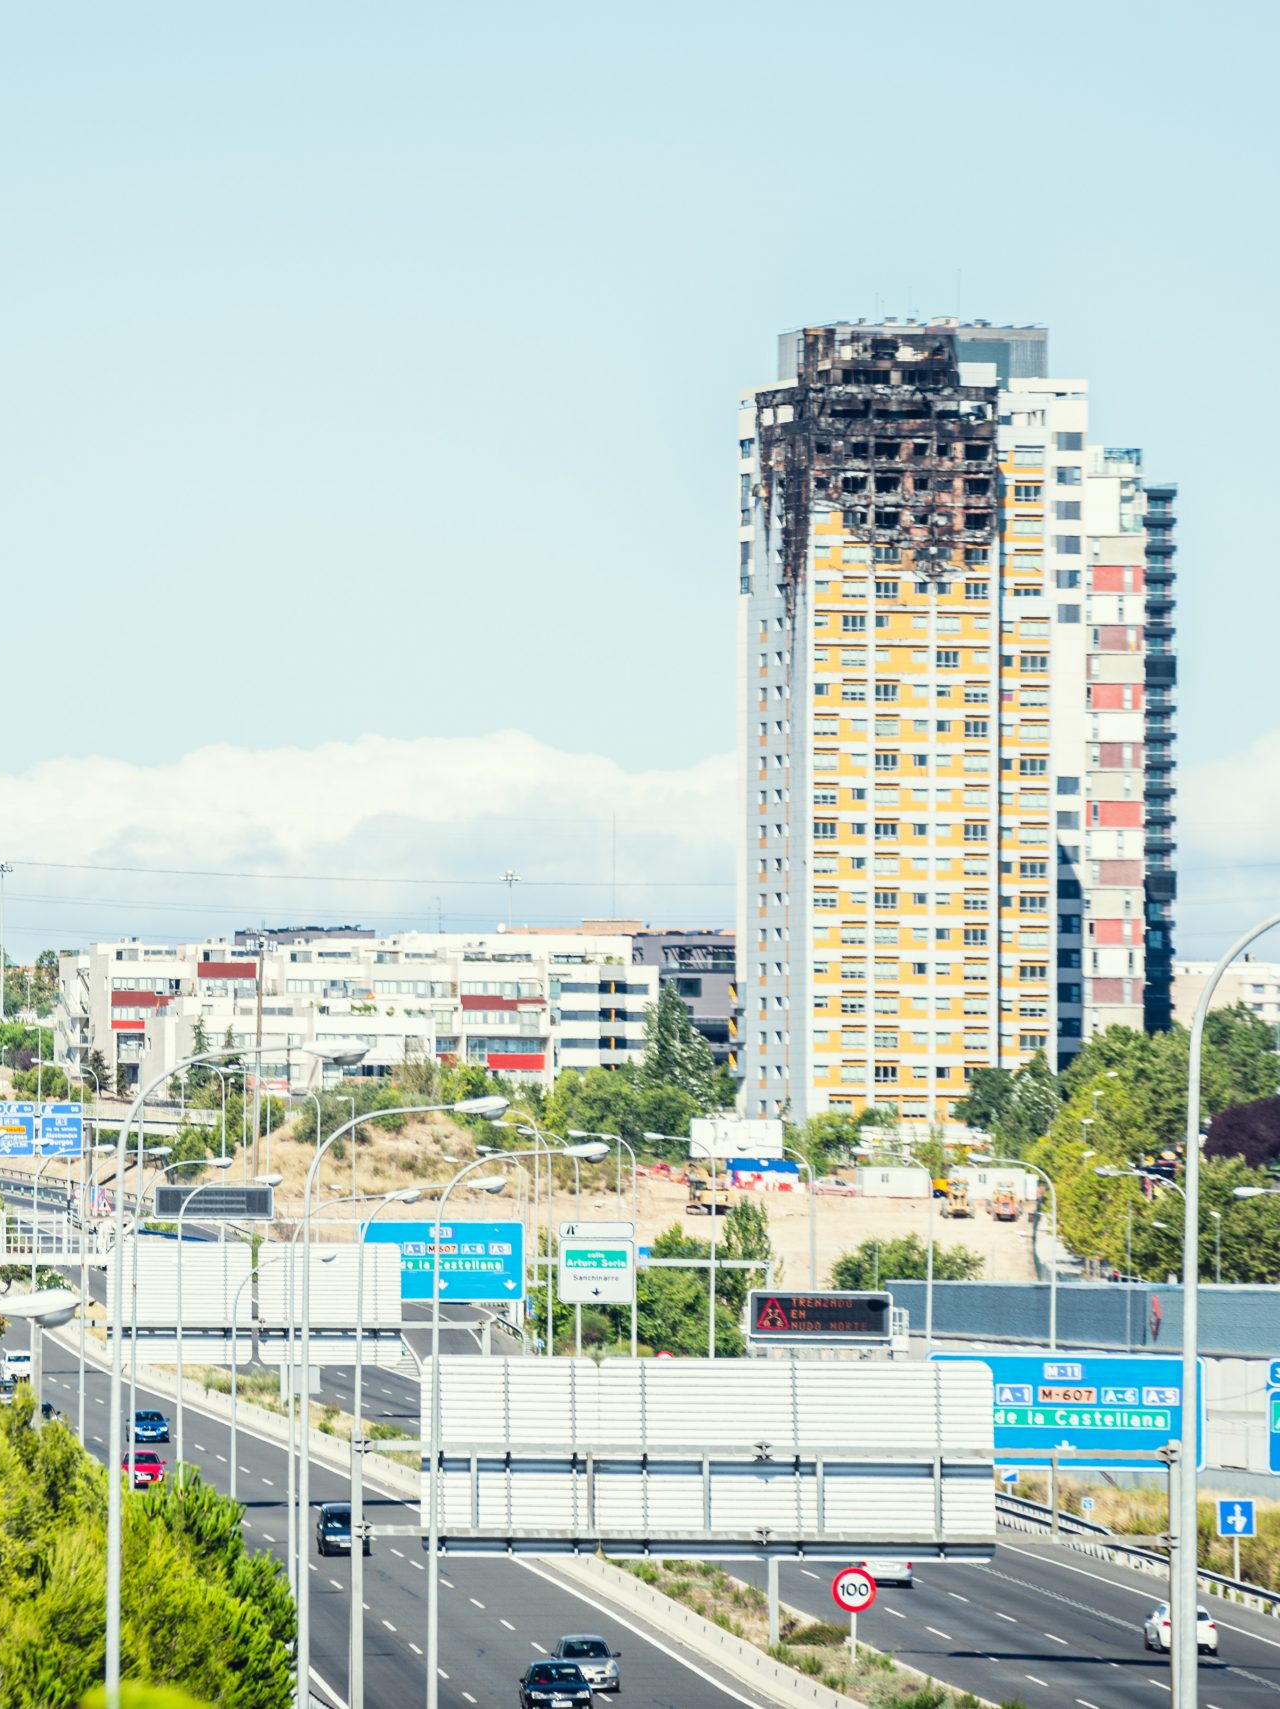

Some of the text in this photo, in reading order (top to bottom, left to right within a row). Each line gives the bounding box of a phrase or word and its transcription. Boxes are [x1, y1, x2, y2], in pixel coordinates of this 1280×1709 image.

[419, 1260, 431, 1270] la
[566, 1258, 627, 1268] Arturo Soria
[791, 1297, 853, 1308] TRENZADO
[790, 1309, 806, 1319] EN
[790, 1321, 868, 1331] NUDO NORTE
[1046, 1366, 1079, 1377] M-11
[1000, 1388, 1030, 1402] A-1
[1041, 1389, 1094, 1401] M-607
[1104, 1390, 1136, 1403] A-6
[1146, 1391, 1177, 1403] A-5
[994, 1409, 1166, 1428] de la Castellana
[840, 1582, 869, 1597] 100
